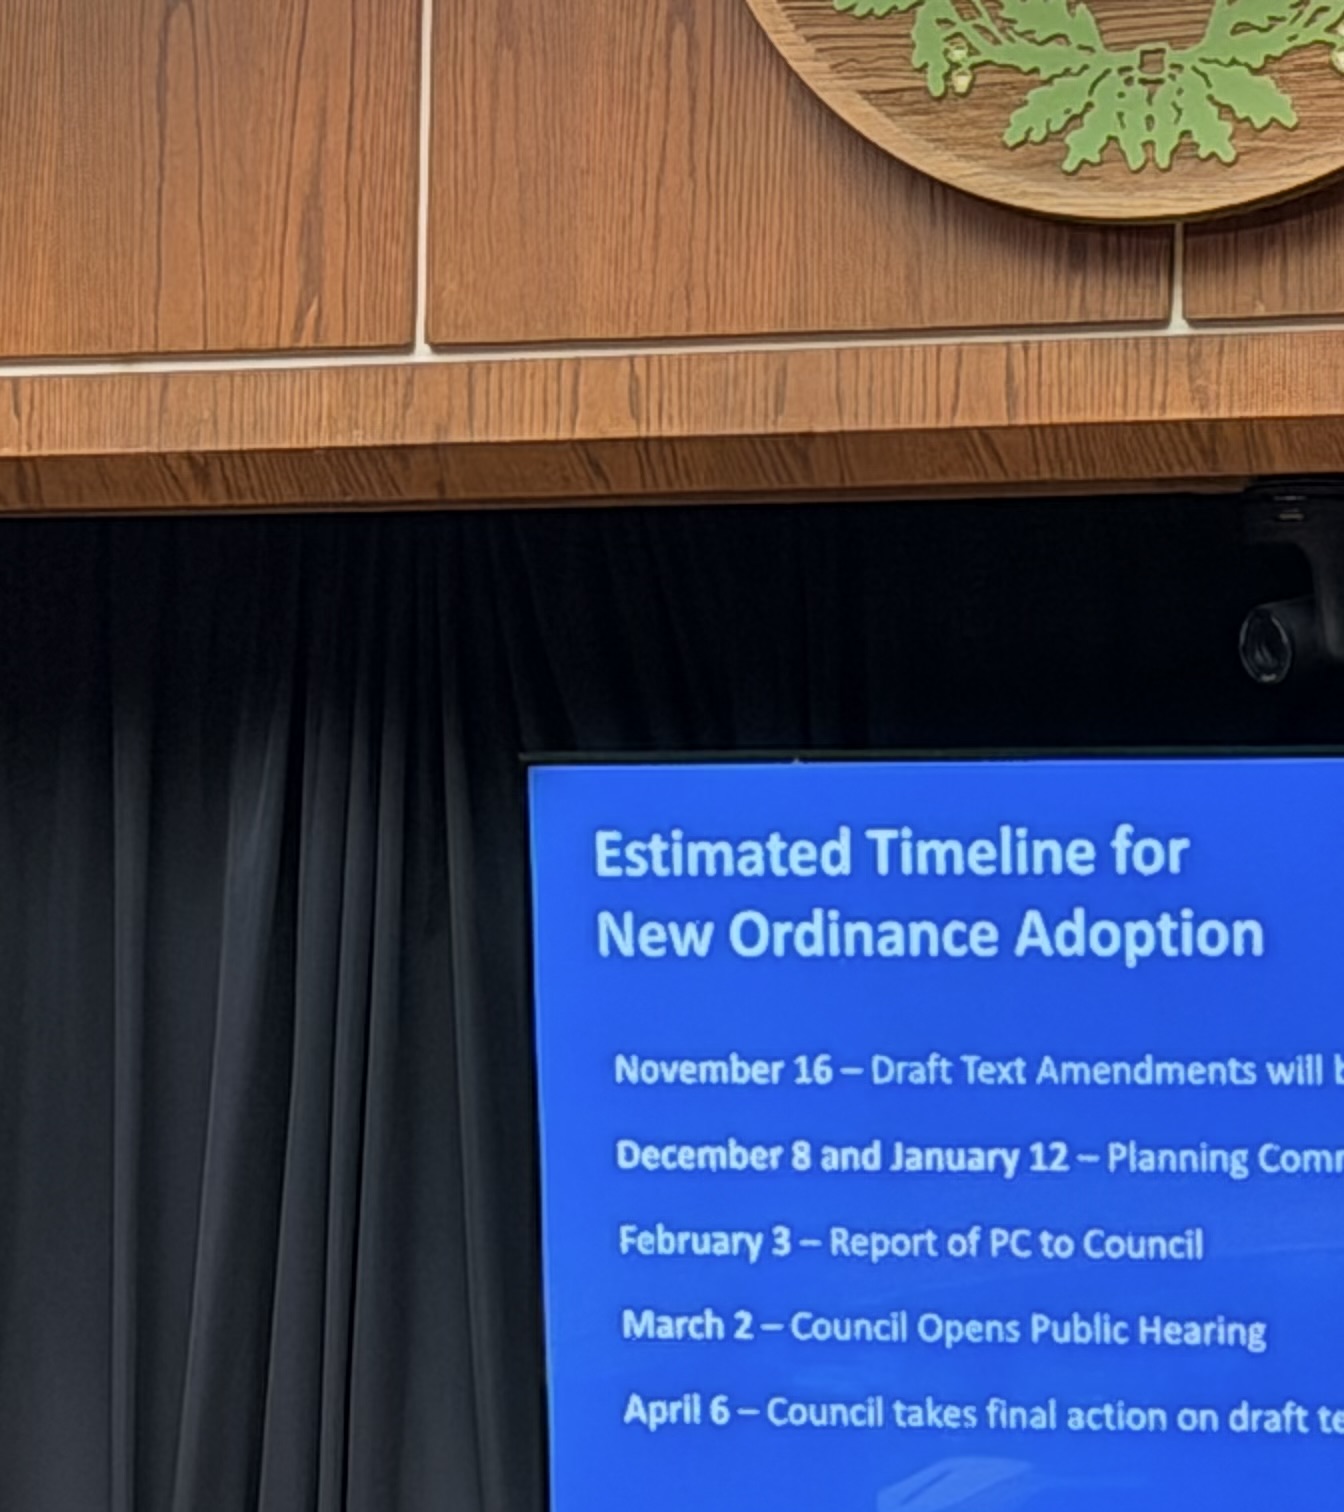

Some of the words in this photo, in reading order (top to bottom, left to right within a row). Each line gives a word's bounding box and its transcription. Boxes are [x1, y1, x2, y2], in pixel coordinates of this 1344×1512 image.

[595, 825, 852, 878] Estimated
[864, 824, 1097, 877] Timeline
[1109, 823, 1191, 877] for
[597, 910, 715, 958] New
[729, 907, 999, 958] Ordinance
[1013, 906, 1264, 969] Adoption
[614, 1051, 785, 1085] November
[793, 1053, 834, 1085] 16
[871, 1051, 953, 1085] Draft
[959, 1054, 1027, 1085] Text
[1035, 1053, 1257, 1086] Amendments
[1265, 1053, 1323, 1086] will
[616, 1137, 785, 1172] December
[791, 1139, 812, 1171] 8
[820, 1139, 882, 1172] and
[889, 1141, 1021, 1179] January
[1029, 1141, 1070, 1172] 12
[1108, 1139, 1249, 1180] Planning
[619, 1222, 764, 1265] February
[771, 1225, 792, 1257] 3
[830, 1226, 939, 1264] Report
[947, 1225, 982, 1257] of
[989, 1227, 1033, 1259] PC
[1038, 1230, 1075, 1259] to
[1083, 1227, 1203, 1260] Council
[622, 1307, 725, 1341] March
[733, 1309, 755, 1341] 2
[790, 1310, 908, 1342] Council
[917, 1312, 1021, 1349] Opens
[1030, 1311, 1129, 1345] Public
[1138, 1315, 1267, 1353] Hearing
[623, 1392, 702, 1433] April
[709, 1394, 731, 1426] 6
[766, 1395, 884, 1428] Council
[892, 1396, 978, 1429] takes
[985, 1397, 1057, 1430] final
[1067, 1400, 1168, 1432] action
[1176, 1407, 1219, 1432] on
[1228, 1400, 1310, 1434] draft
